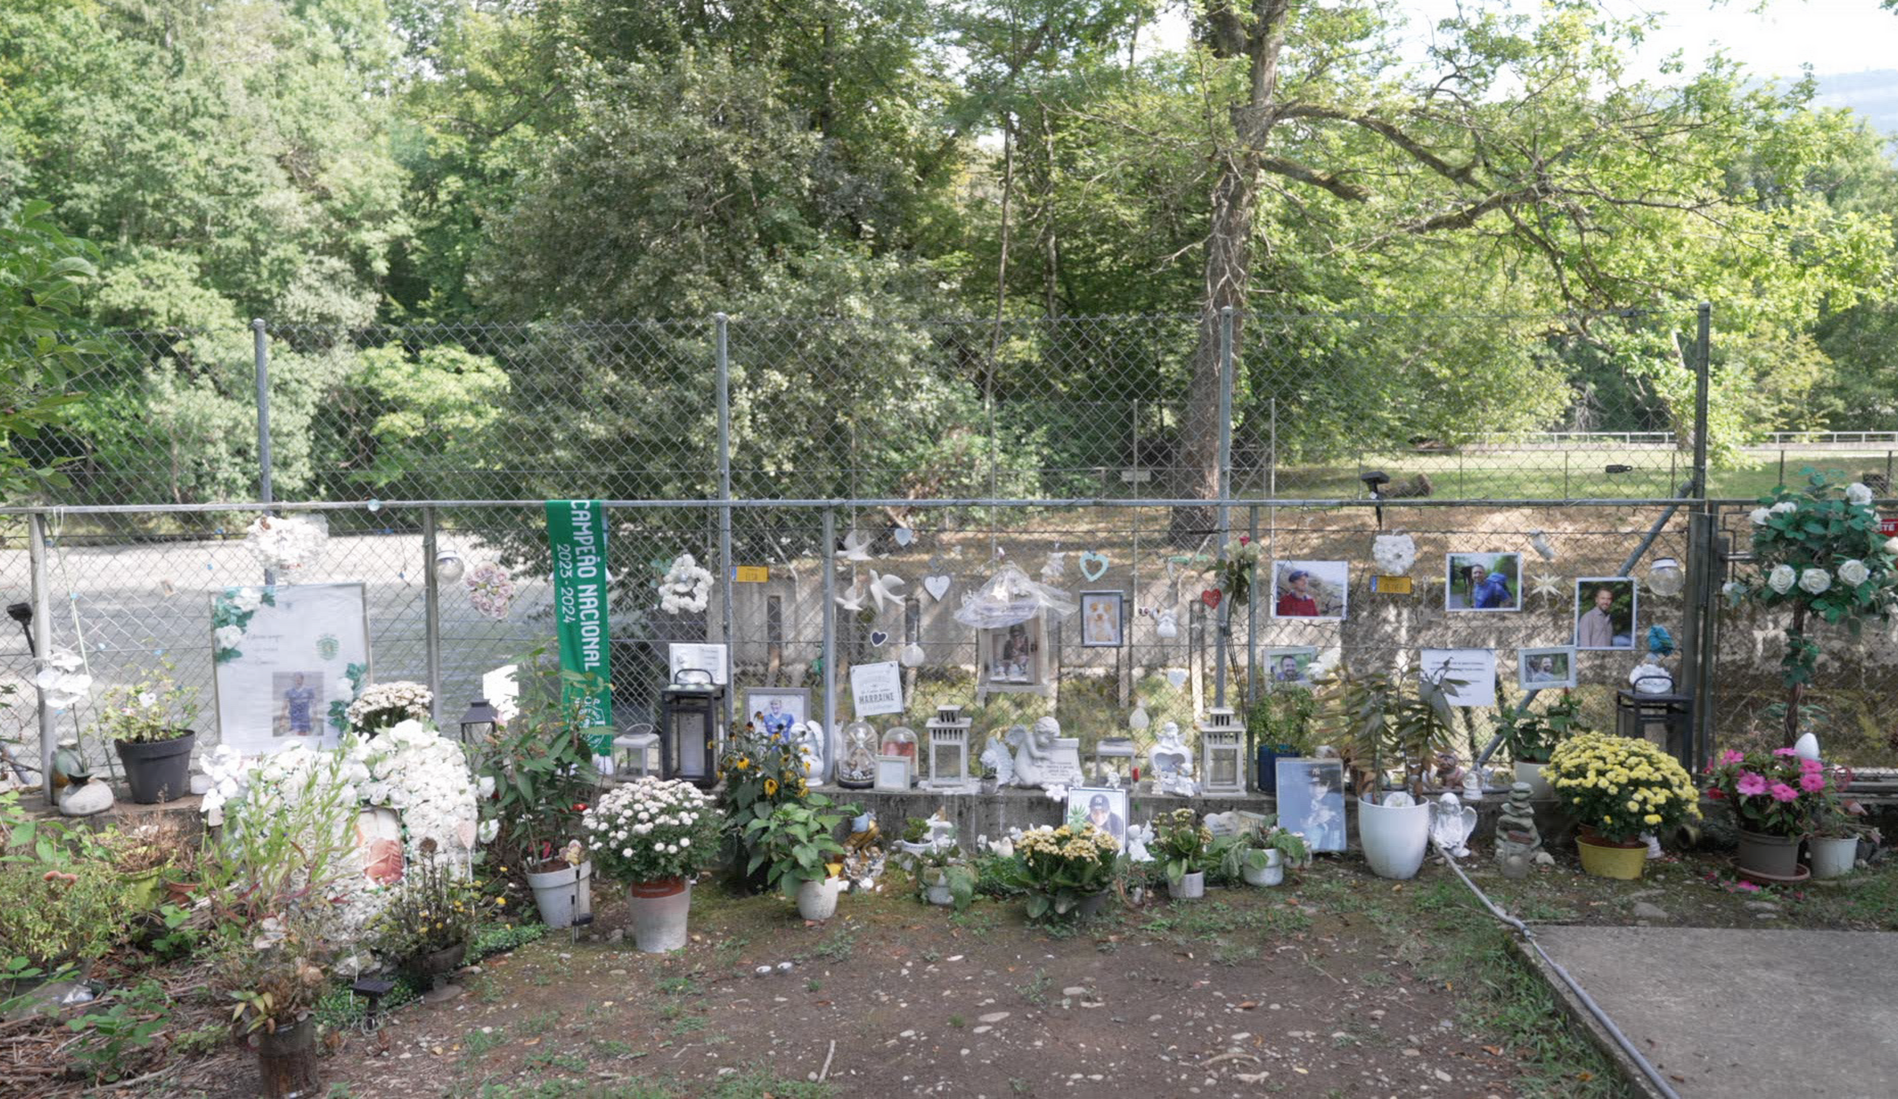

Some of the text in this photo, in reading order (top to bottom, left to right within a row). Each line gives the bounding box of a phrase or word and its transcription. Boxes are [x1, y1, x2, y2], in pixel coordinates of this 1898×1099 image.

[557, 543, 572, 578] 2023
[570, 500, 600, 671] CAMPEÃO NACIONAL
[561, 587, 576, 624] 2024
[858, 693, 894, 704] MARRAINE
